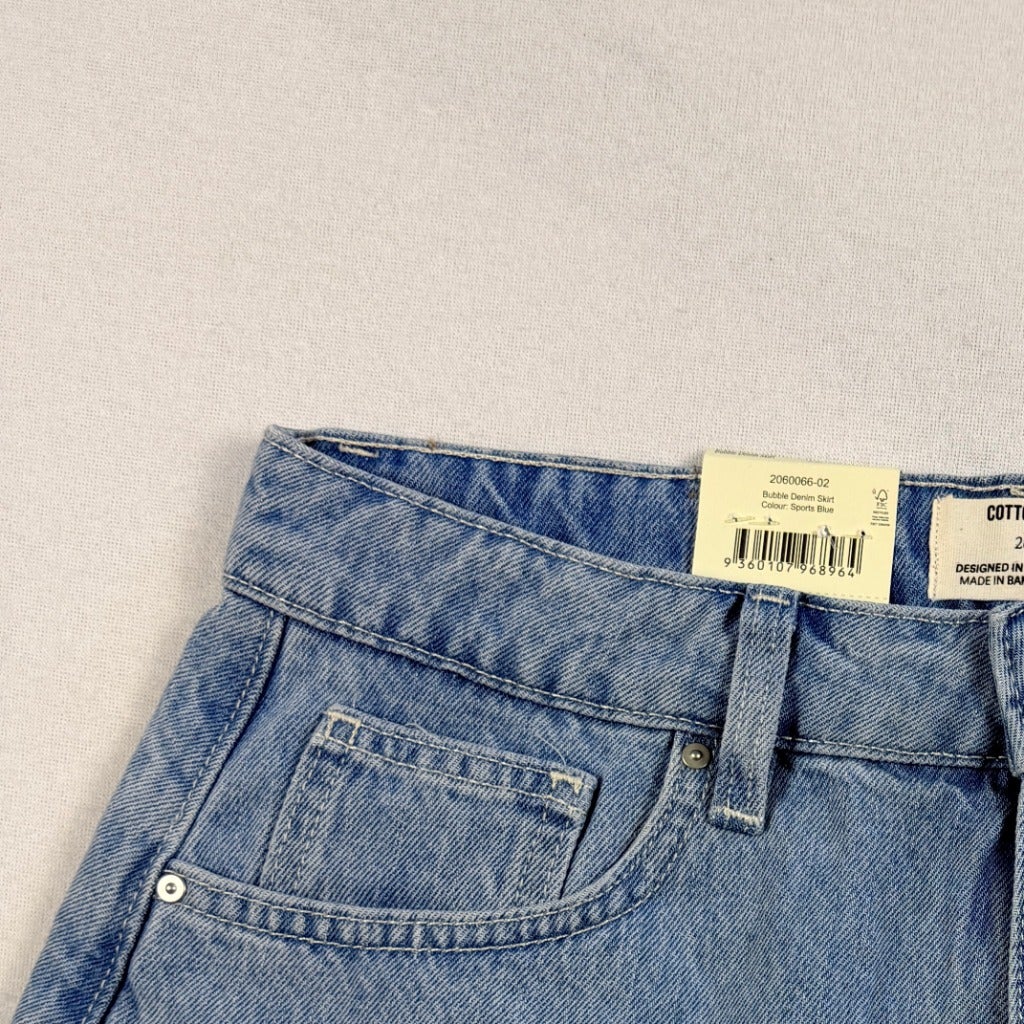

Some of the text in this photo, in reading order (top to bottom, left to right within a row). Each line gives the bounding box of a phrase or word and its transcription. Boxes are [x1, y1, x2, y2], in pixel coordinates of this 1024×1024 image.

[769, 474, 830, 488] 2060066-02
[762, 490, 835, 503] Bubble Denim Skirt
[761, 501, 834, 513] Colour: Sports Blue
[724, 558, 731, 568] 9
[955, 563, 1009, 573] DESIGNED
[1011, 563, 1024, 573] IN
[959, 576, 990, 586] MADE
[993, 576, 1004, 585] IN
